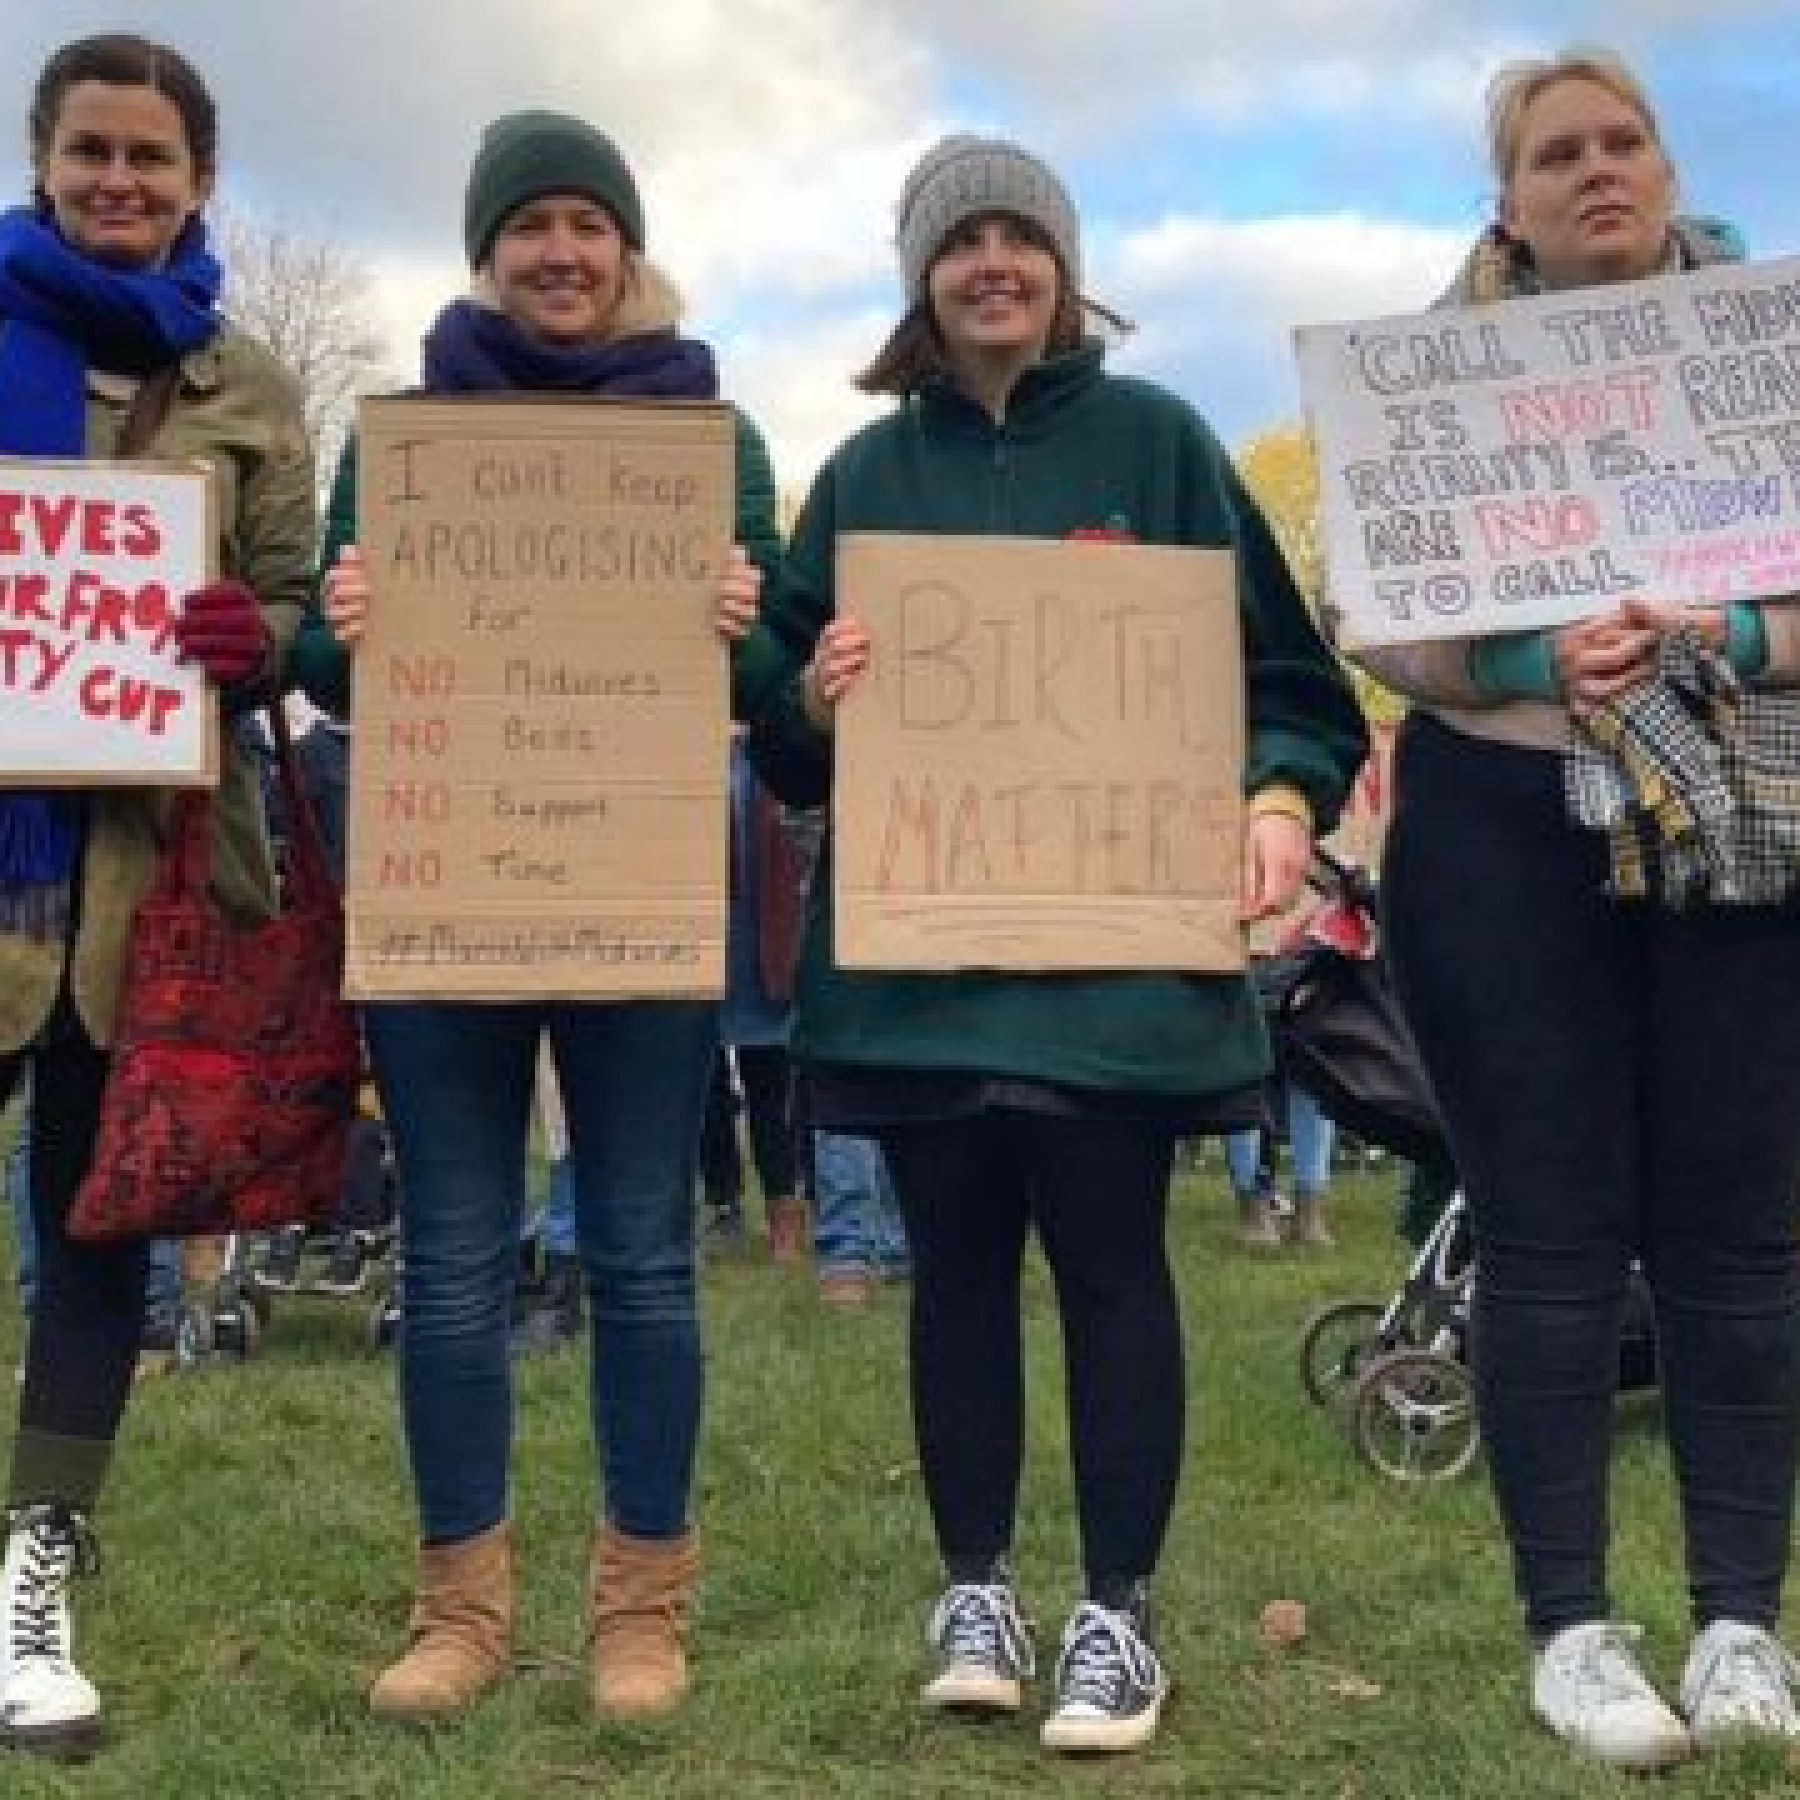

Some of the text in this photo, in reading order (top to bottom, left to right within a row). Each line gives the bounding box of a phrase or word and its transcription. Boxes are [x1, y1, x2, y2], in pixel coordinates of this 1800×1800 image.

[1541, 298, 1682, 366] THE
[1384, 400, 1467, 451] IS
[1498, 364, 1661, 443] NOT
[383, 438, 437, 506] I
[388, 521, 710, 584] APOLOGISING
[1363, 508, 1462, 569] ARE
[1473, 494, 1600, 559] NO
[1374, 573, 1471, 621] TO
[1492, 548, 1646, 606] CALL
[388, 653, 458, 700] NO
[896, 578, 1228, 752] BIRTH
[79, 664, 185, 736] CUT
[388, 719, 452, 757] NO
[382, 780, 452, 824] NO
[378, 849, 441, 887] NO
